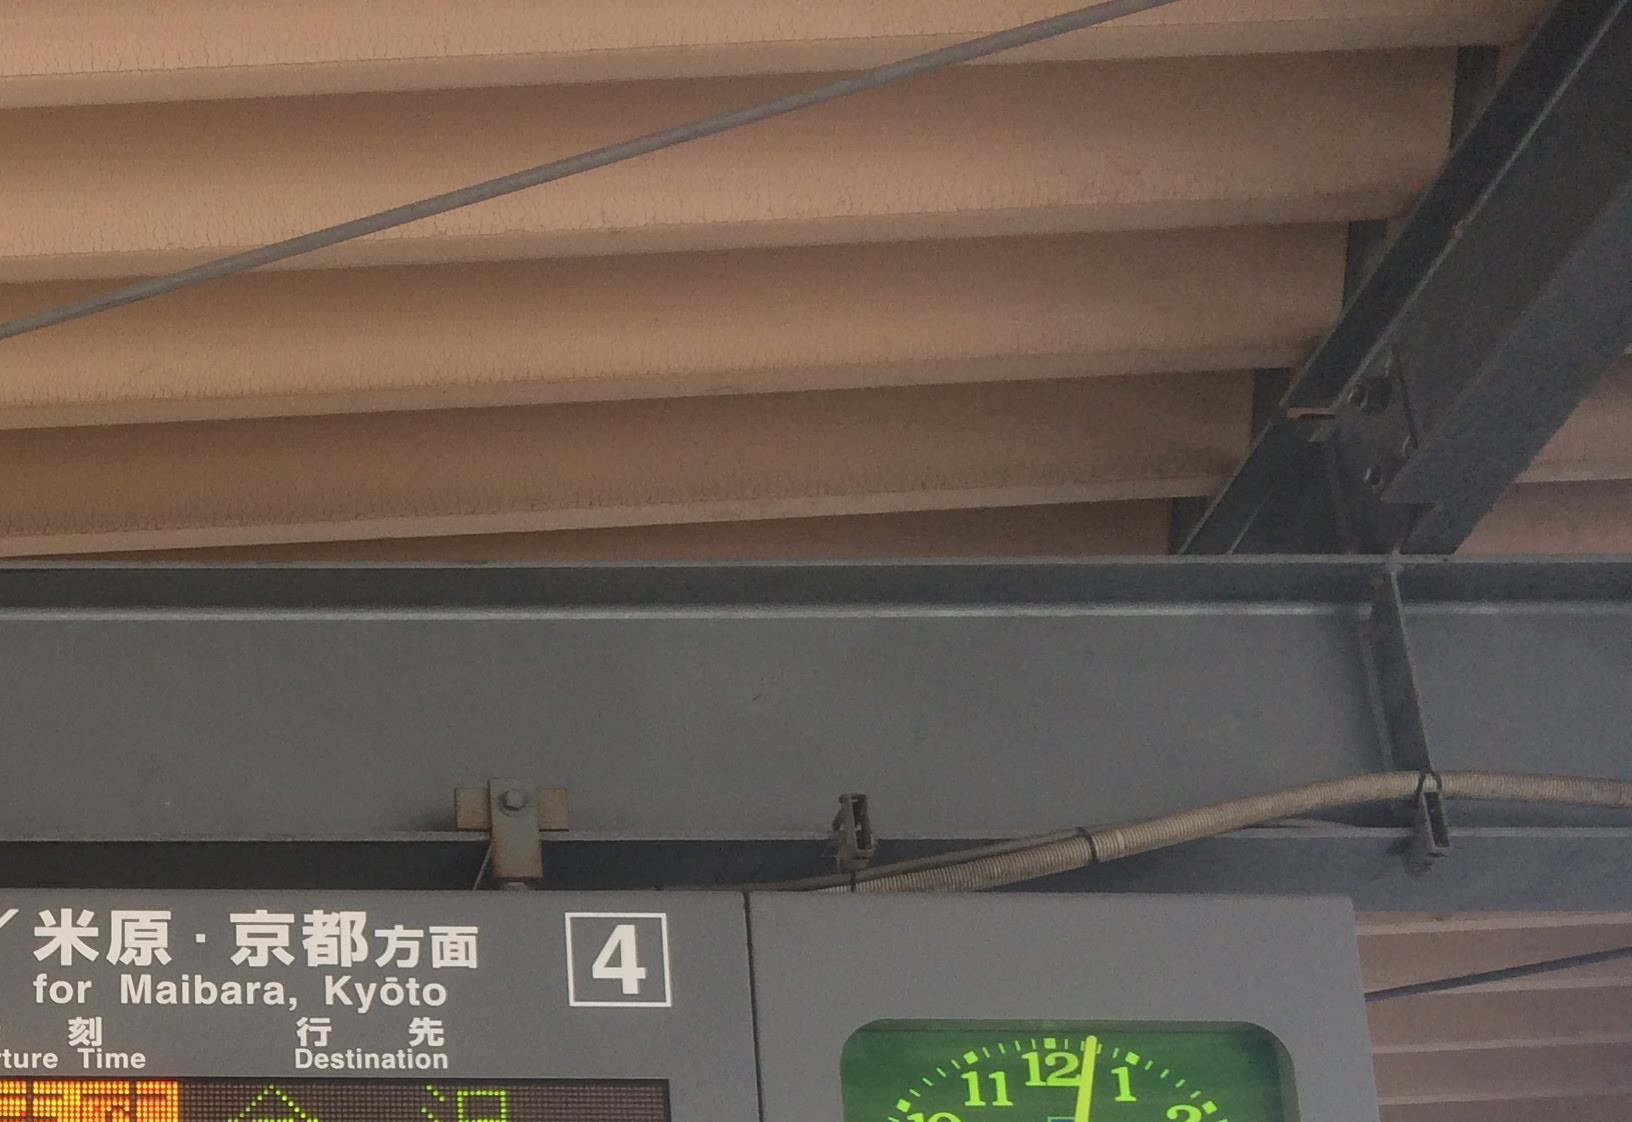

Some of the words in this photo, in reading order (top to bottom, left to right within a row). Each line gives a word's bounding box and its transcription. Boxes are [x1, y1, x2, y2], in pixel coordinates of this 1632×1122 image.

[592, 924, 646, 995] 4
[33, 973, 92, 1004] for
[120, 974, 298, 1011] Maibara,
[325, 975, 447, 1014] Kyōto
[77, 1047, 147, 1069] Time
[295, 1047, 448, 1070] Destination
[1021, 1051, 1081, 1087] 12
[964, 1071, 1013, 1106] 11
[1114, 1066, 1137, 1102] 1
